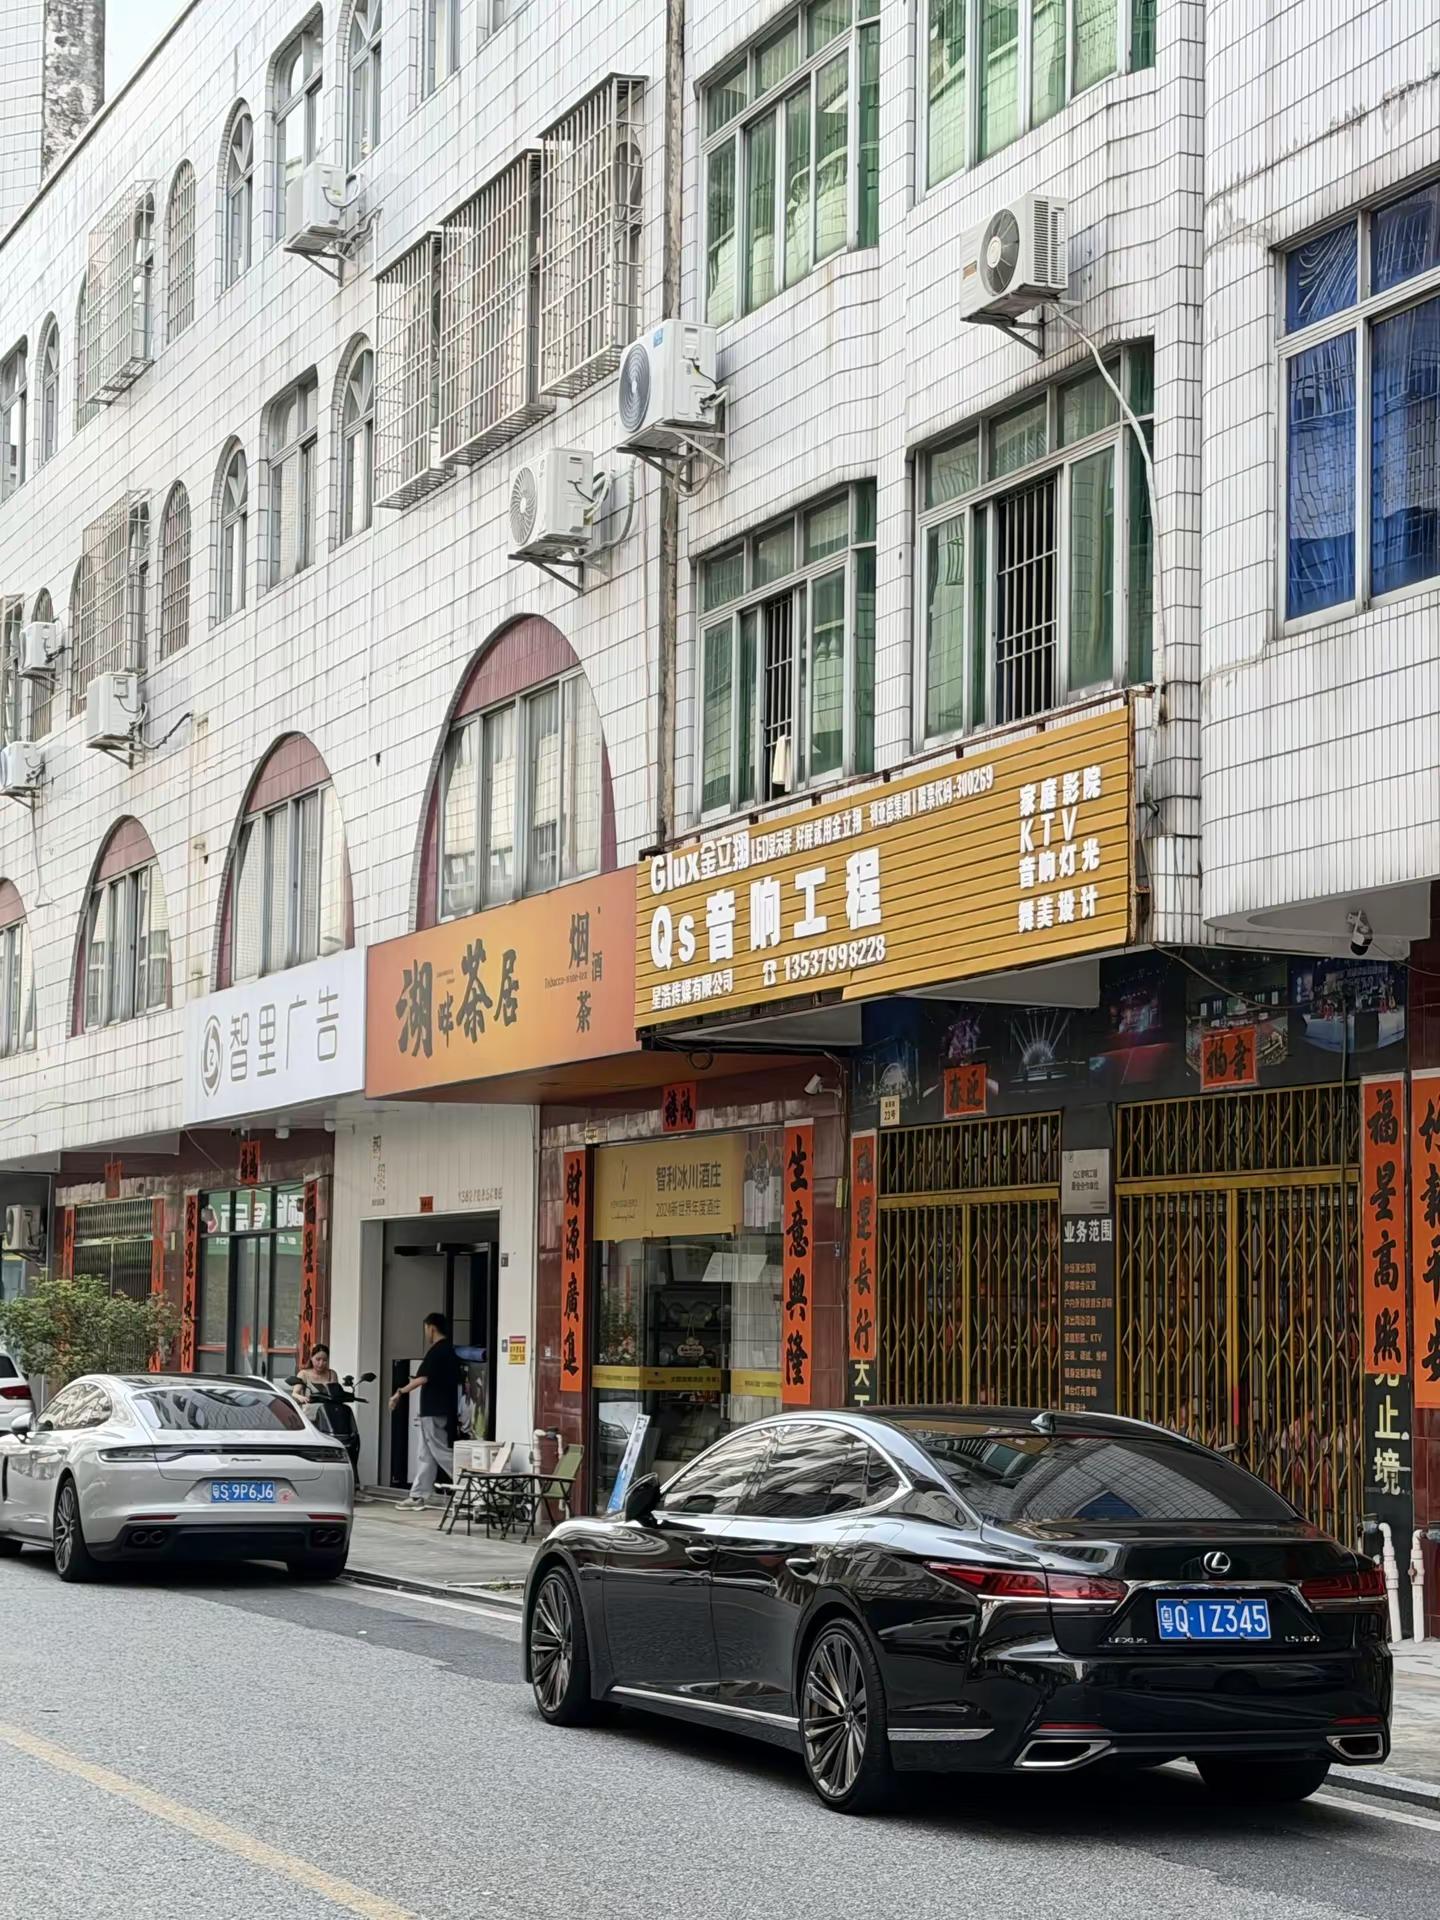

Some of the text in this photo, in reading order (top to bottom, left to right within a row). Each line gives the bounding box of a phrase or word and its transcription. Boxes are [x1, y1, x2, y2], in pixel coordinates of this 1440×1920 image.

[1019, 765, 1102, 816] 家庭影院
[650, 830, 750, 894] Glux金立翔
[1019, 838, 1100, 889] 音响灯光
[784, 935, 886, 981] 13537998228
[230, 985, 340, 1082] 智里广告
[656, 1161, 722, 1193] 智利冰川酒庄
[1063, 1218, 1113, 1243] 业务范围
[1367, 1088, 1402, 1367] 福星高照
[785, 1134, 809, 1387] 生意興隆
